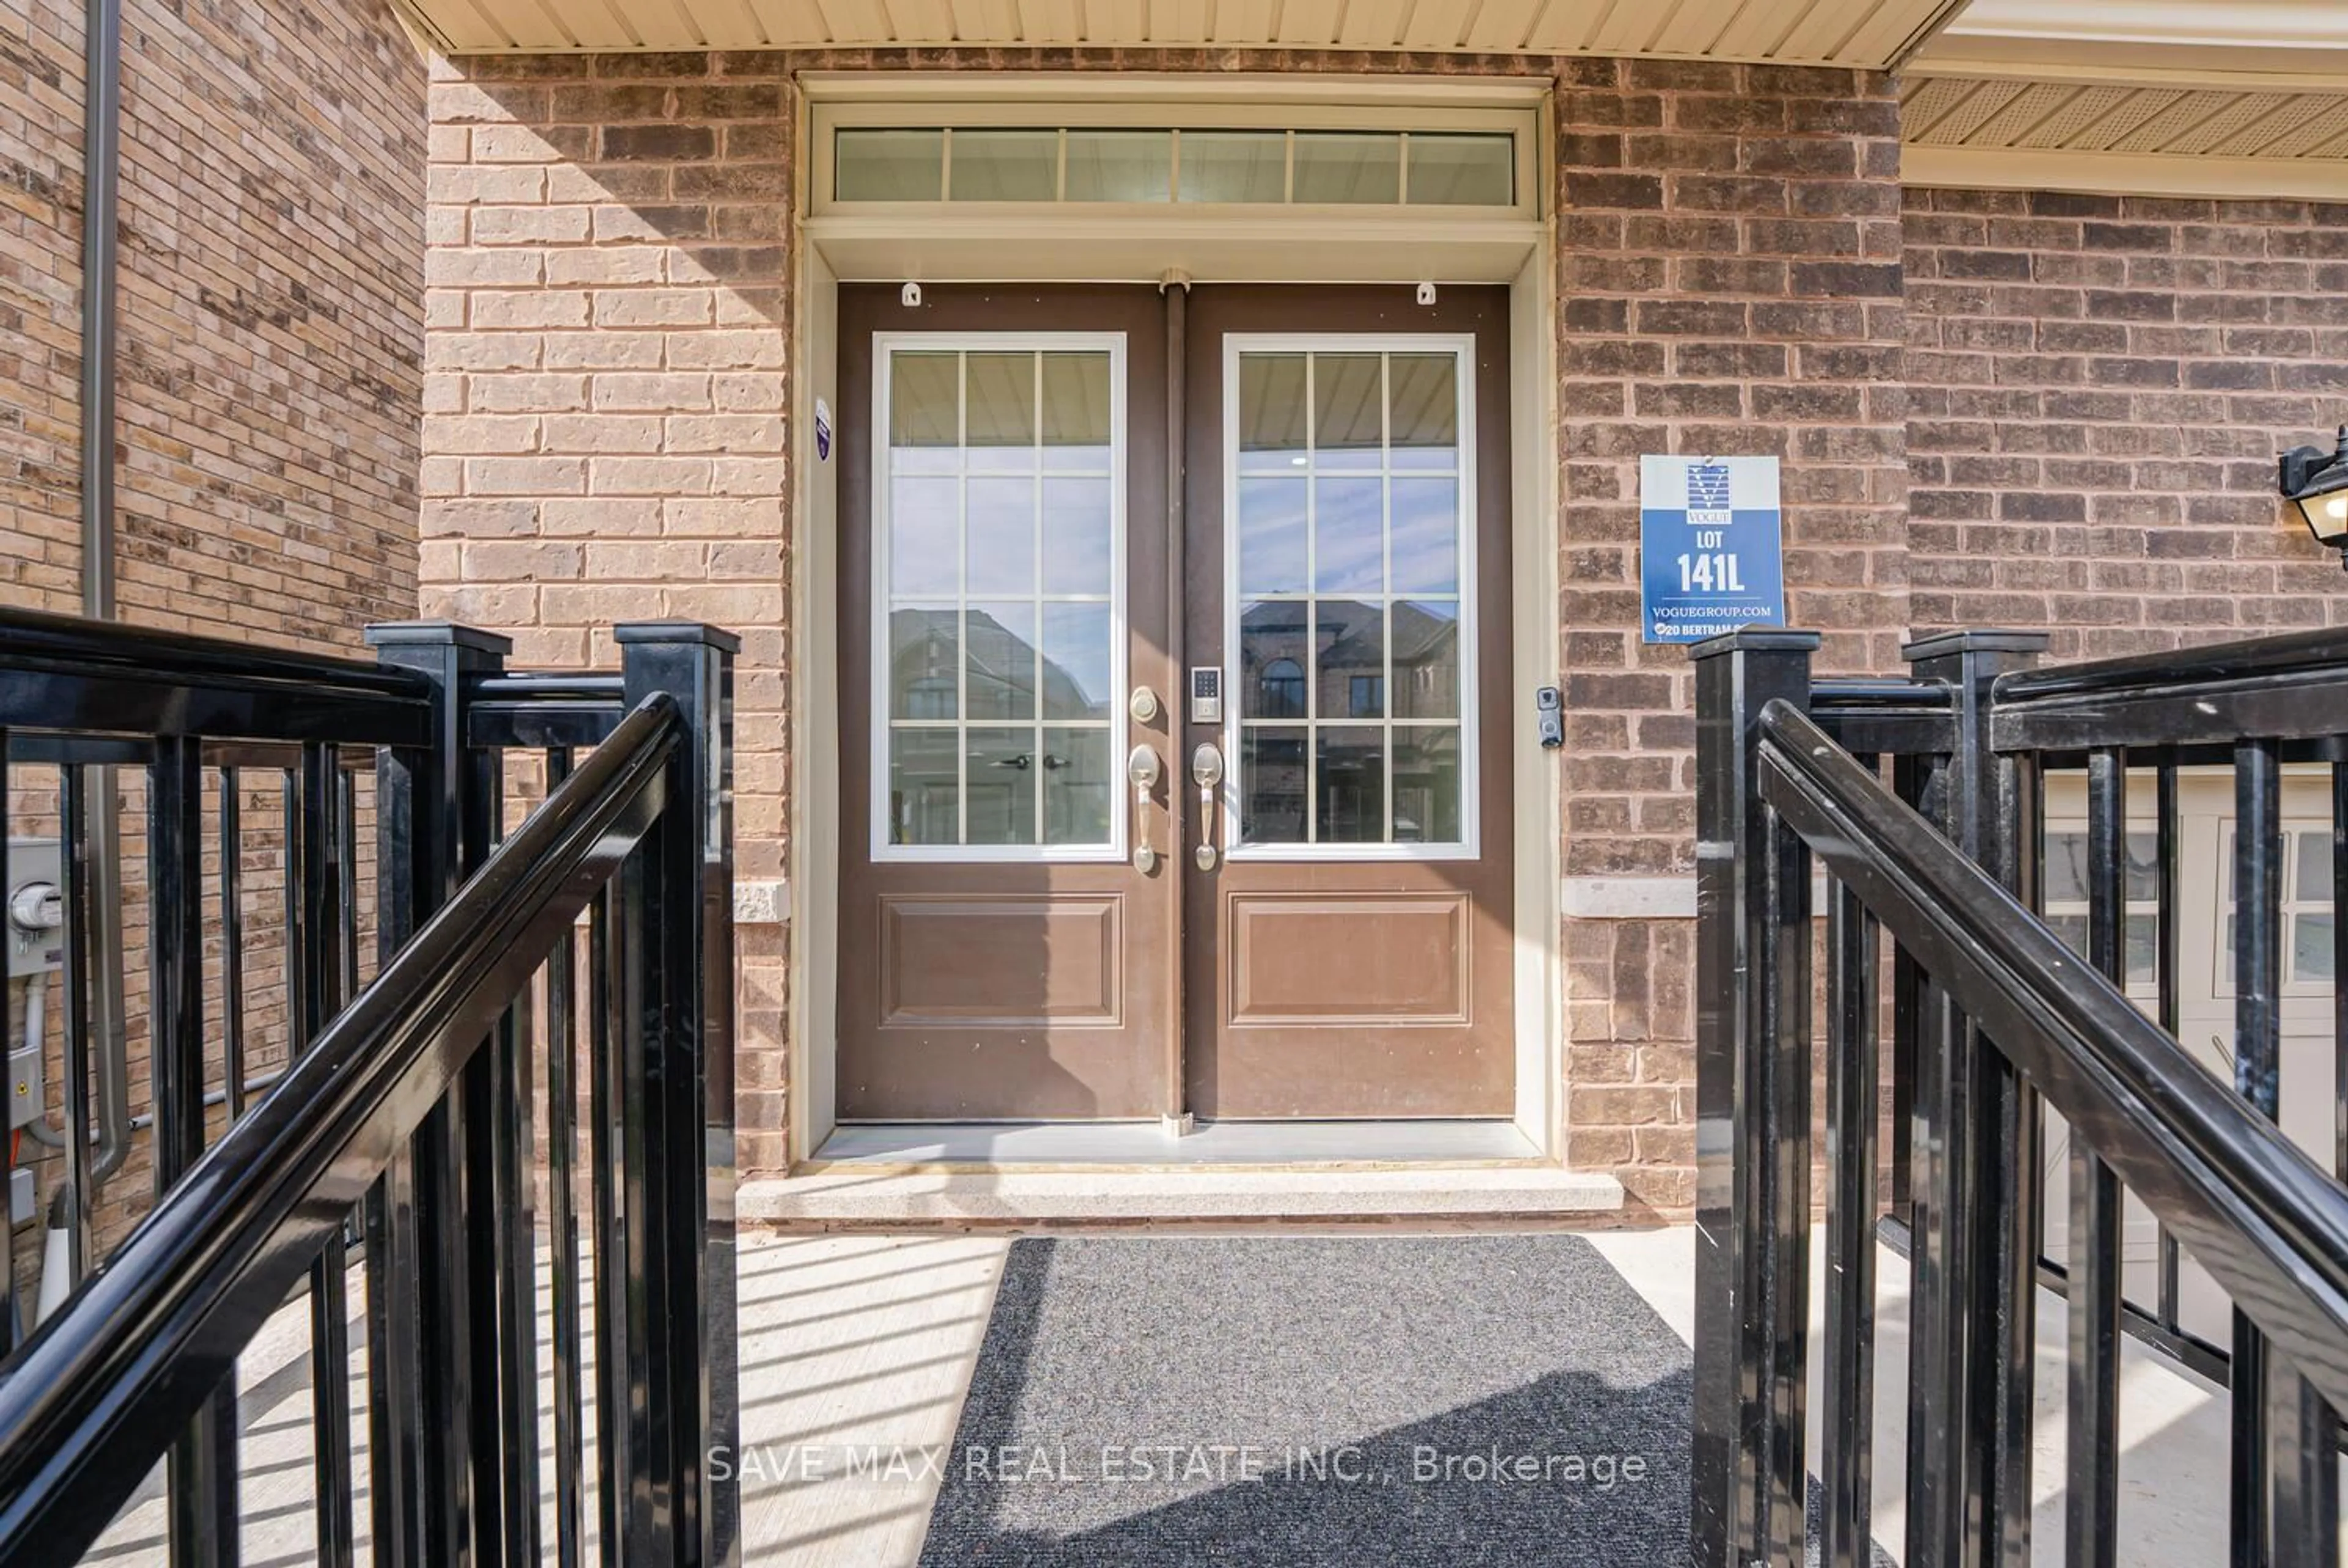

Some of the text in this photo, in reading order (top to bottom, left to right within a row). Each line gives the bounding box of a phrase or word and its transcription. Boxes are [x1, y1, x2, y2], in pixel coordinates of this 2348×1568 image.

[1697, 531, 1723, 548] LOT
[1678, 554, 1744, 591] 141L
[1653, 607, 1770, 617] VOGUEGROUP.COM
[1682, 624, 1731, 636] BERTRAM
